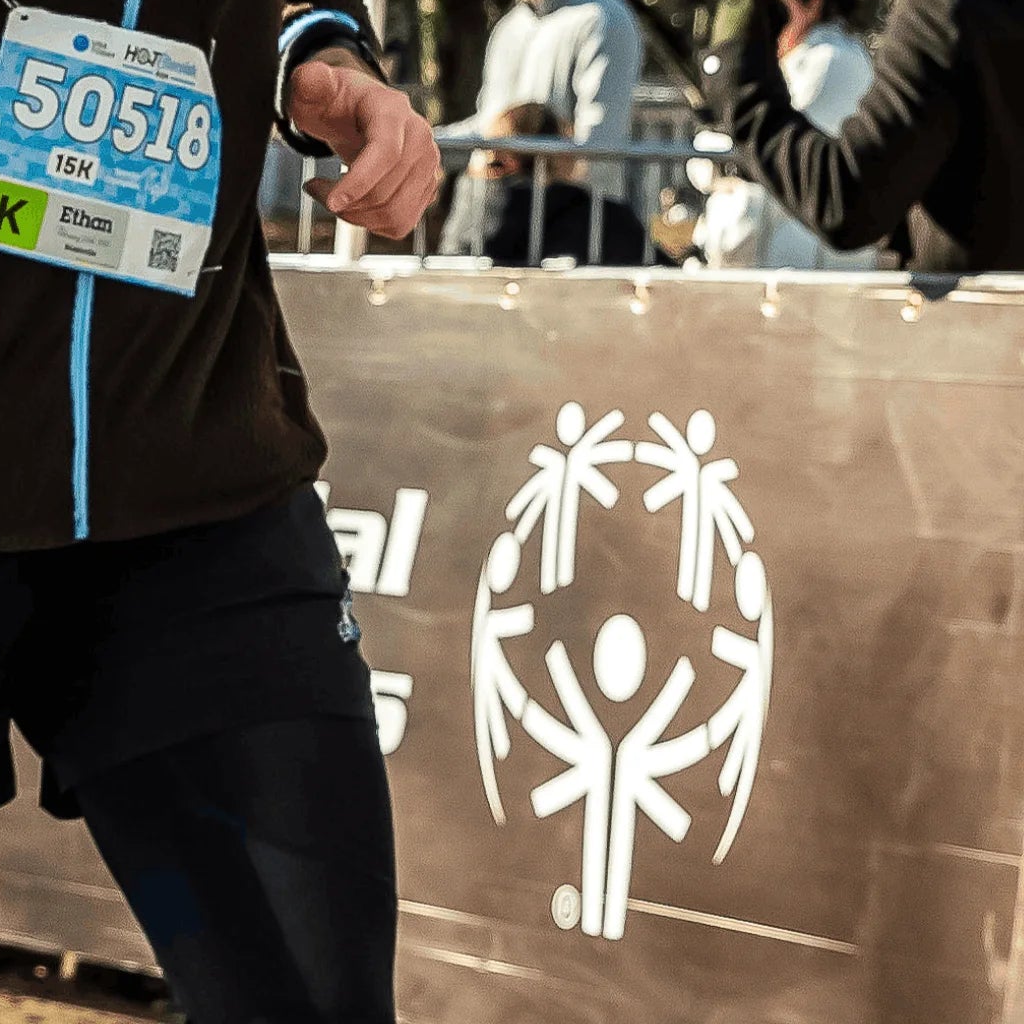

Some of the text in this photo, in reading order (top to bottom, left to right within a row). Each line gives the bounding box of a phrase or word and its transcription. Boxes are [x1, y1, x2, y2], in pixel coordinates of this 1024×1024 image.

[12, 57, 211, 170] 50518
[55, 153, 94, 180] 15K
[59, 205, 113, 234] Ethan
